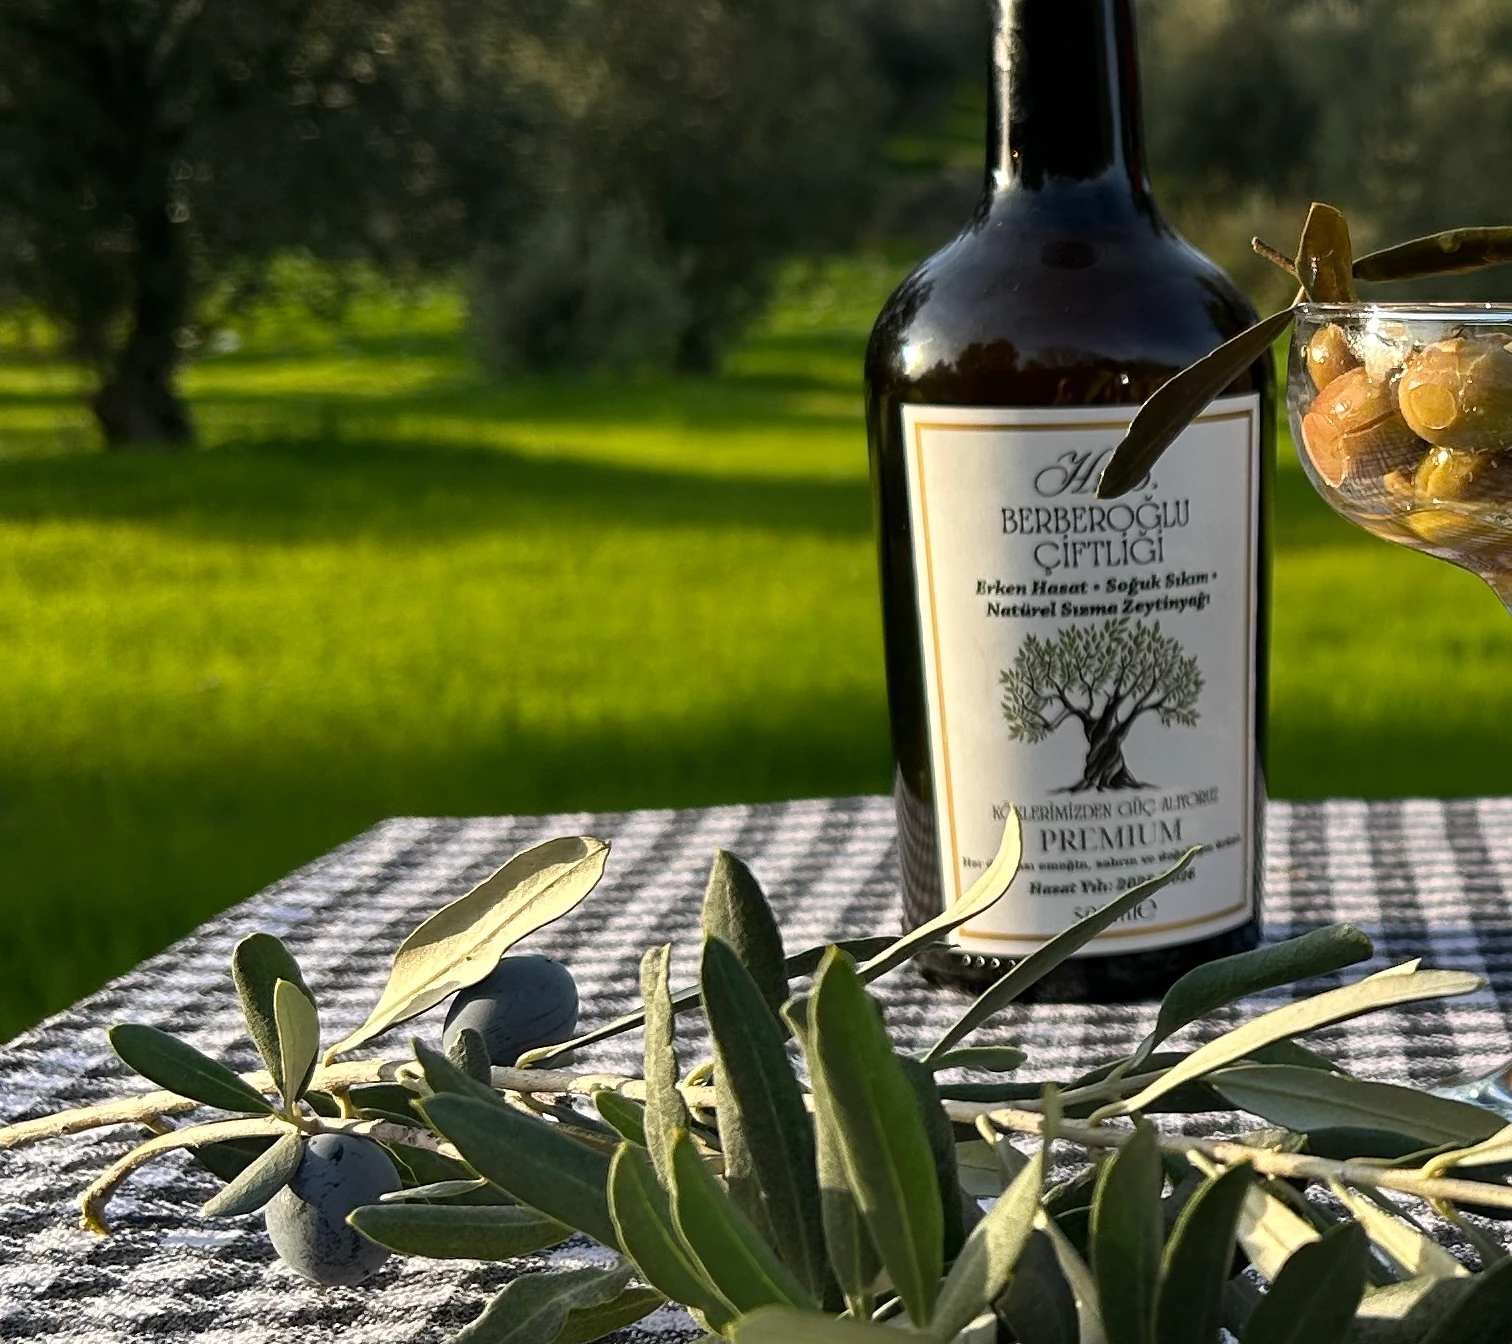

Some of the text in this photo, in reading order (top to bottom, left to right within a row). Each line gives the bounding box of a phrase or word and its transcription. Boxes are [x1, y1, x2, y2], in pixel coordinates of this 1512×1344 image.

[1001, 495, 1190, 535] BERBEROĞLU
[1034, 529, 1164, 576] ÇİFTLİĞİ
[976, 571, 1209, 597] Erken Hasat Soğuk Sıkım
[987, 600, 1057, 618] Natürel
[1122, 592, 1211, 618] Zeytinyağı
[1117, 794, 1156, 818] GÜÇ
[1040, 818, 1183, 853] PREMIUM
[1029, 880, 1077, 896] Hasat
